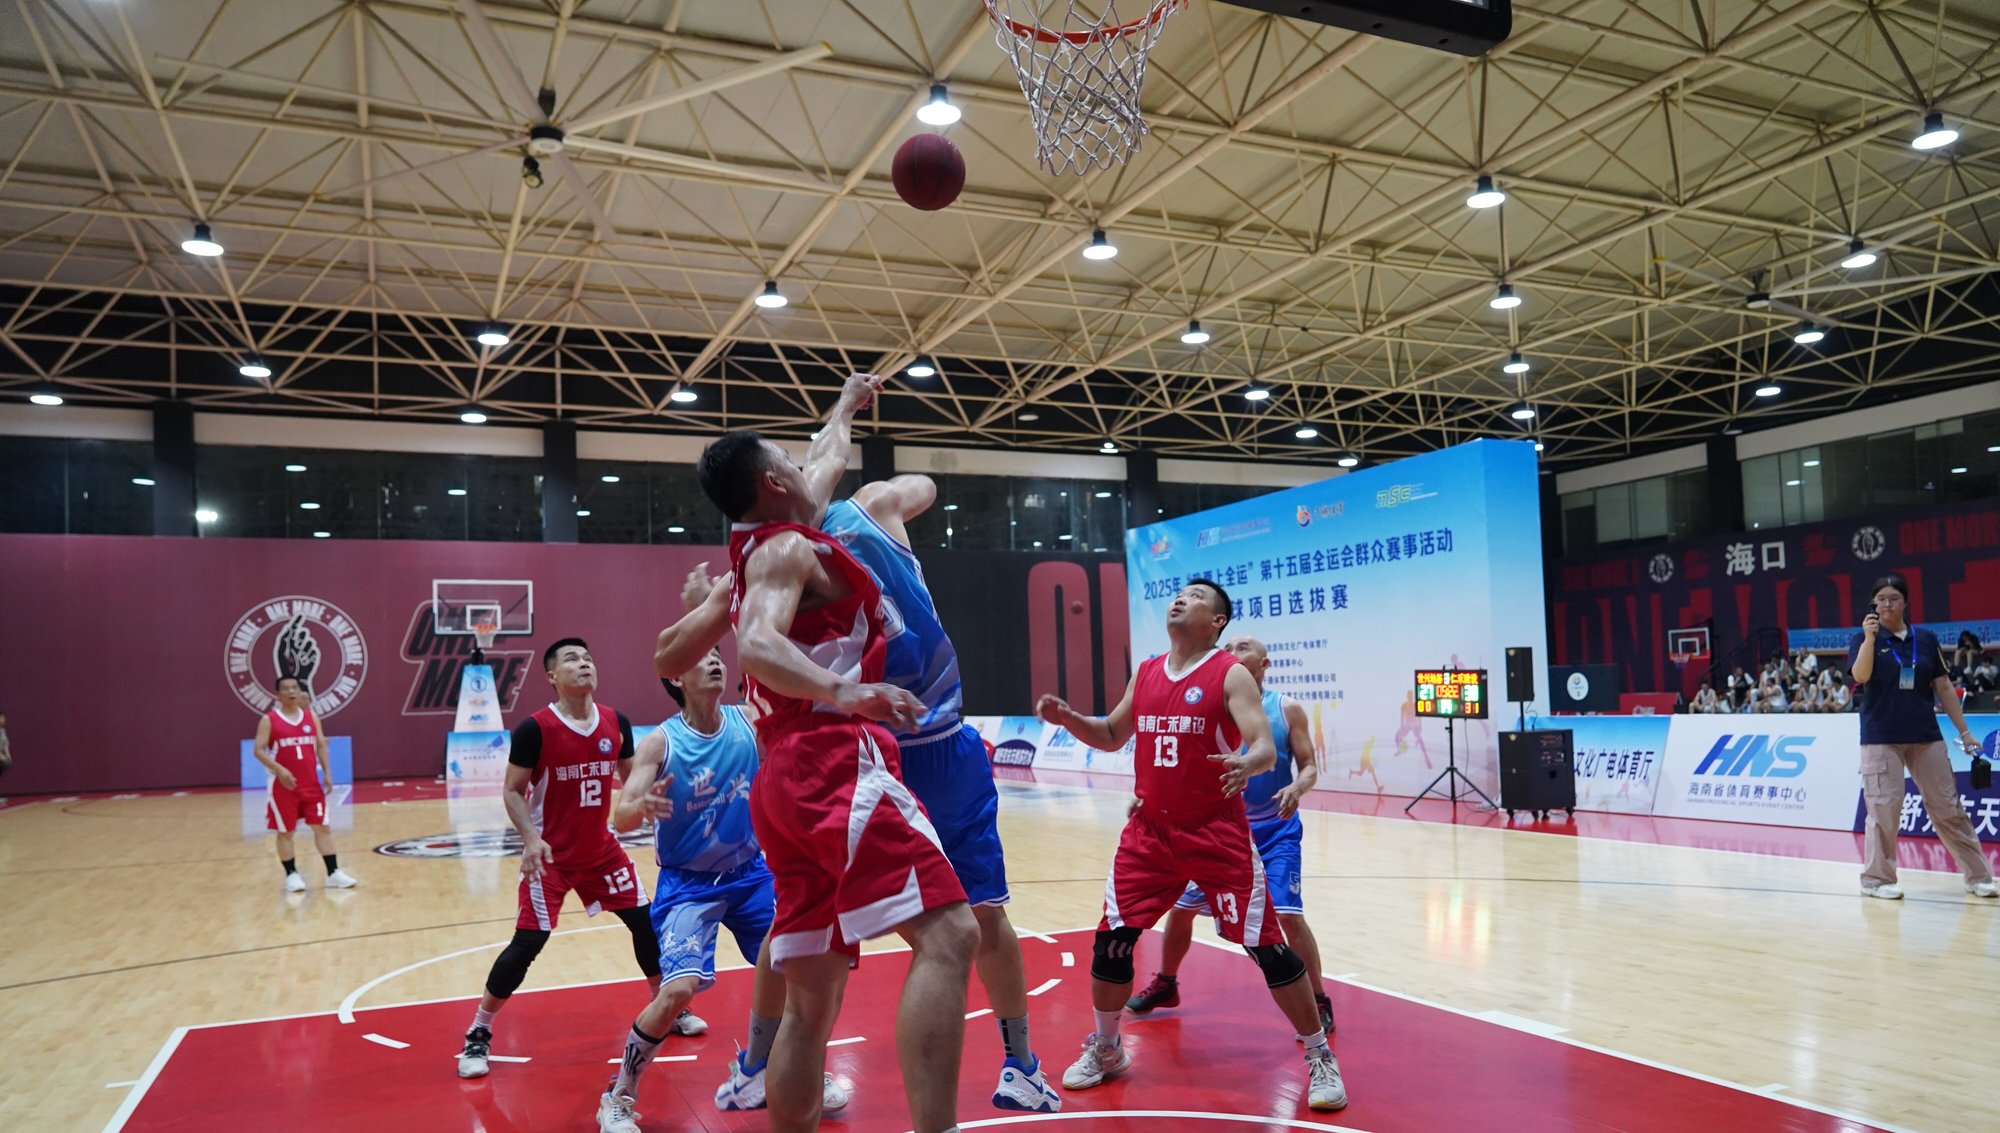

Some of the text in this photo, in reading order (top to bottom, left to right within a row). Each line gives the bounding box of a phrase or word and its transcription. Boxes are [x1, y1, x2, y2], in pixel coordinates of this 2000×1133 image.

[1724, 541, 1786, 577] 海口
[265, 600, 327, 620] ONE MORE
[328, 615, 363, 665] ONE MORE
[295, 745, 304, 760] 1
[1153, 735, 1179, 768] 13
[1573, 748, 1655, 780] 文化广电体育厅
[1693, 734, 1817, 778] HNS
[579, 779, 602, 808] 12
[1688, 782, 1807, 802] 海南省体育赛事中心
[701, 808, 717, 839] 7
[603, 866, 635, 895] 12
[1216, 892, 1239, 924] 13
